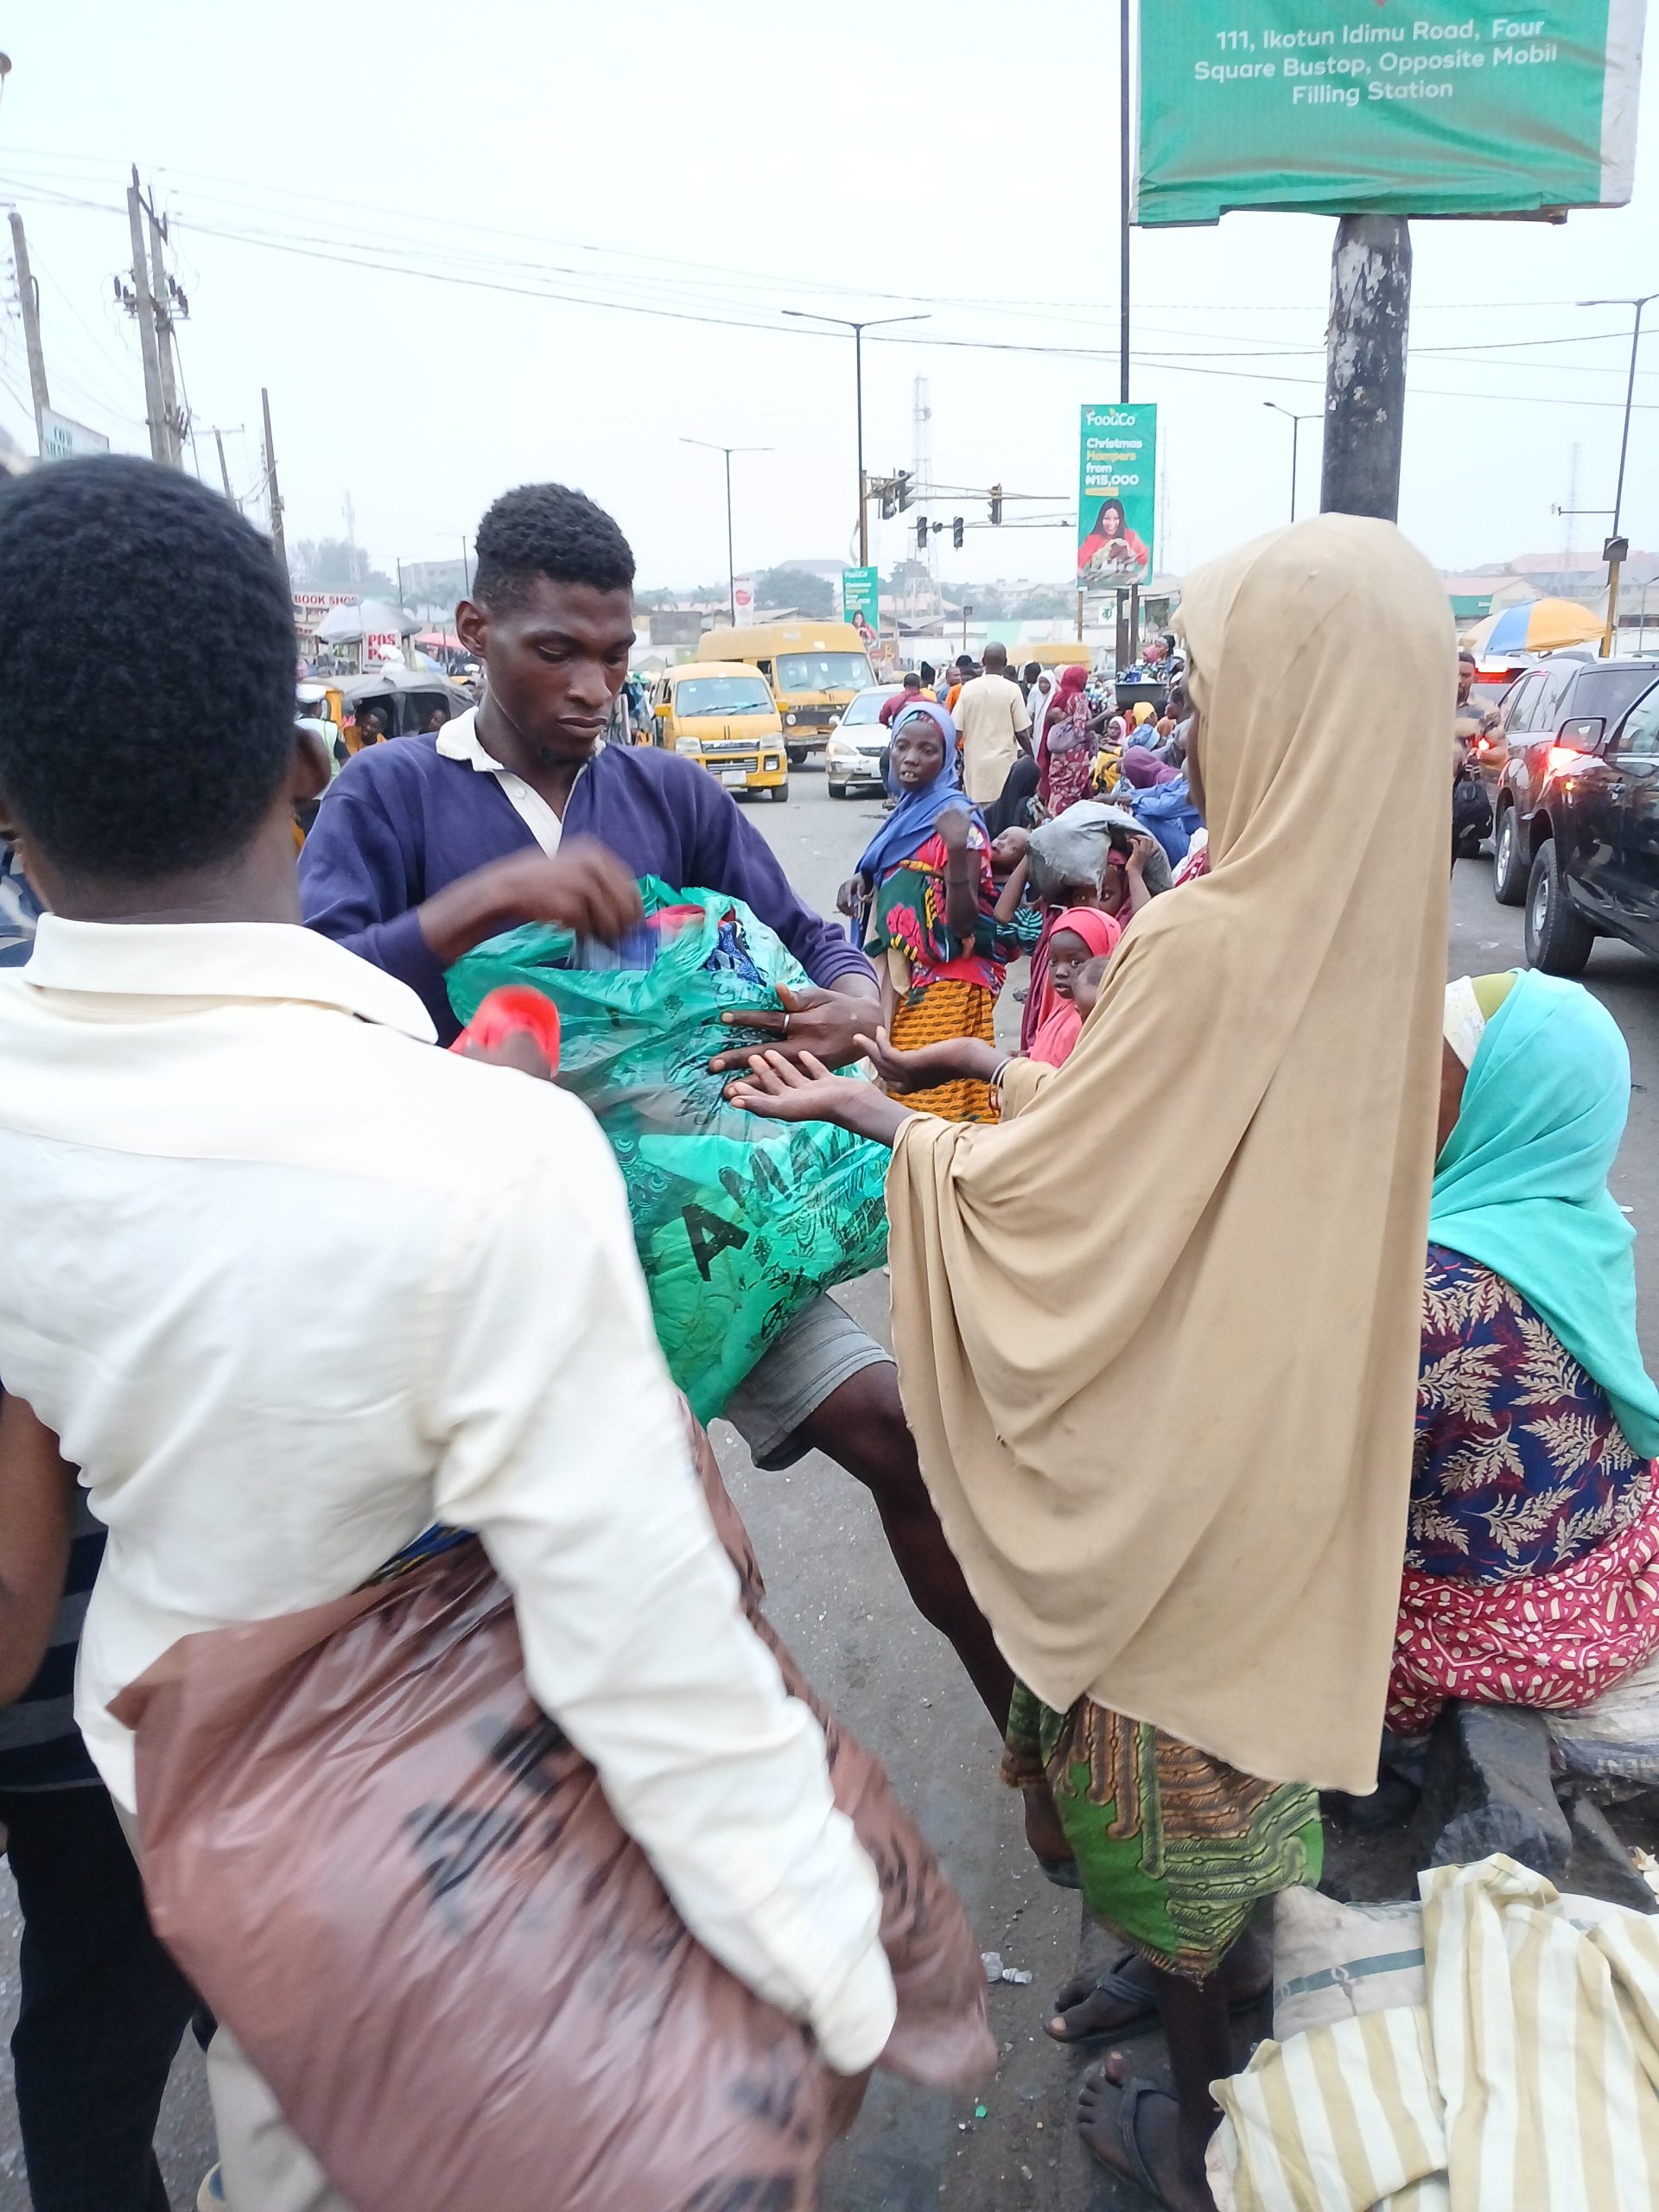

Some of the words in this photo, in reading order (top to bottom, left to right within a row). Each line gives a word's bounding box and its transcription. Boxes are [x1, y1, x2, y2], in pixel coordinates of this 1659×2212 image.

[1216, 30, 1256, 53] 111,
[1262, 29, 1335, 49] Ikotun
[1342, 23, 1405, 44] Idimu
[1412, 19, 1481, 42] Road,
[1491, 18, 1546, 40] Four
[1194, 60, 1276, 84] Square
[1282, 56, 1372, 78] Bustop,
[1378, 48, 1485, 76] Opposite
[1491, 44, 1558, 67] Mobil
[1292, 84, 1361, 107] Filling
[1367, 79, 1454, 101] Station
[1086, 410, 1136, 426] FoodCo
[1086, 437, 1143, 448] Christmas
[1085, 462, 1113, 474] from
[295, 594, 325, 605] BOOK
[368, 633, 396, 646] POS
